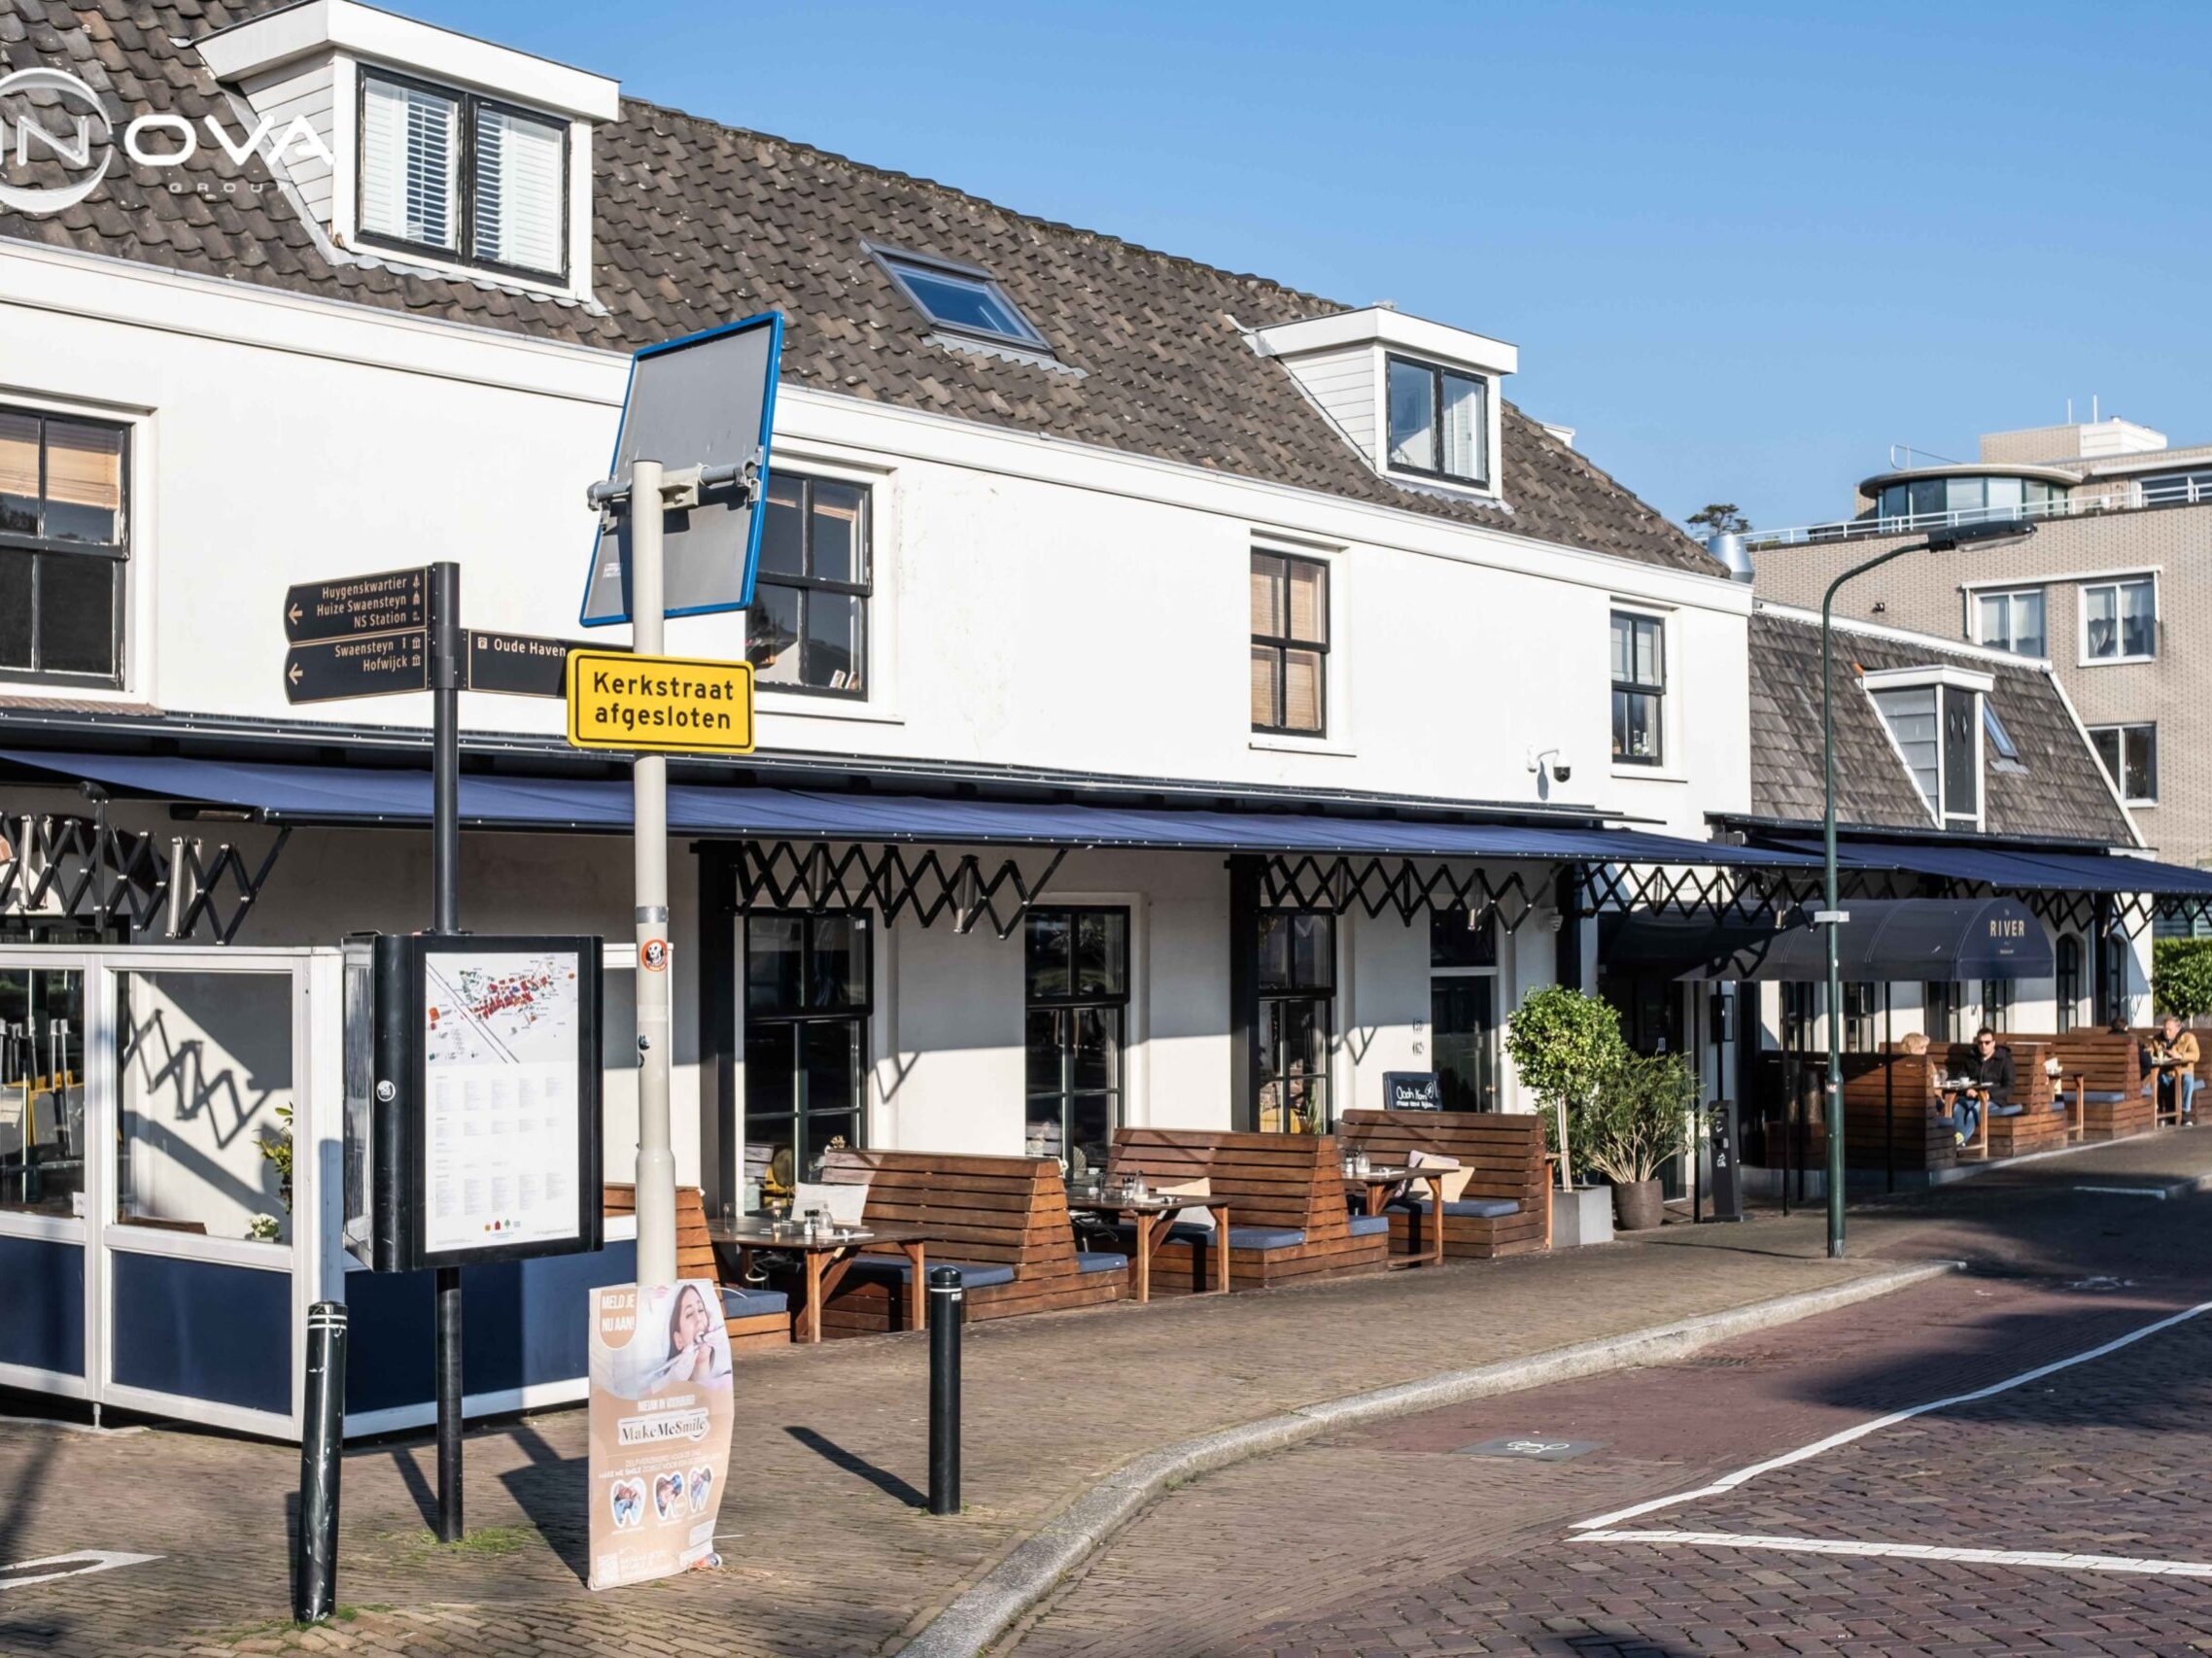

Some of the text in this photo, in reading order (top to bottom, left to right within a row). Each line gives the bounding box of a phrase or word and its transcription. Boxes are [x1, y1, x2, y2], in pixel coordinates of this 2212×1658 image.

[322, 576, 407, 601] Huygenskwartier
[316, 595, 406, 617] Huize Swaensteyn
[354, 610, 406, 629] NS Station
[334, 641, 394, 657] Swaensteyn
[494, 639, 526, 654] Oude
[530, 641, 566, 657] Haven
[363, 655, 407, 673] Hofwijck
[594, 671, 733, 701] Kerkstraat
[595, 703, 731, 731] afgesloten
[1989, 919, 2024, 937] RIVER
[602, 1295, 625, 1310] MELD
[602, 1317, 613, 1332] NU
